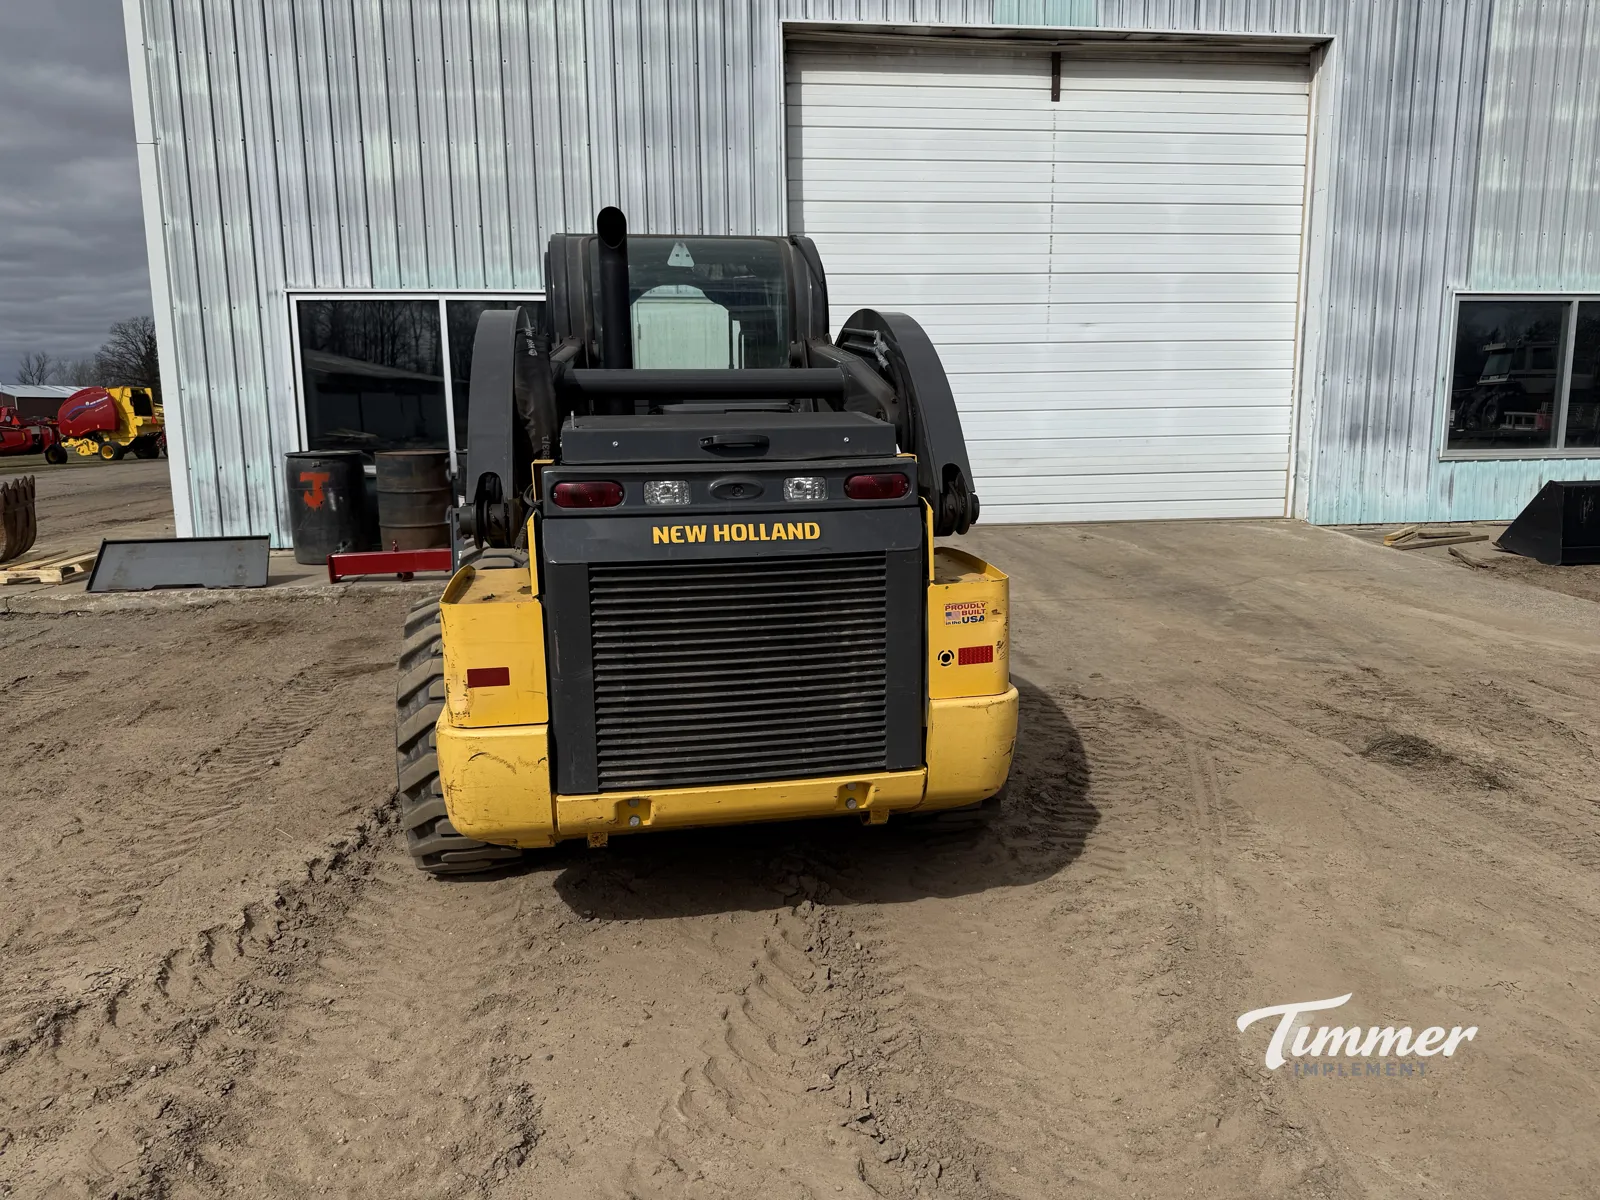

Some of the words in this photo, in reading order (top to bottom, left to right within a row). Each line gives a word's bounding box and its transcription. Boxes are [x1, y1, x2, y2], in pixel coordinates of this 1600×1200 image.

[652, 525, 707, 544] NEW
[713, 522, 821, 542] HOLLAND
[945, 603, 986, 611] PROUDLY
[962, 615, 985, 624] USA
